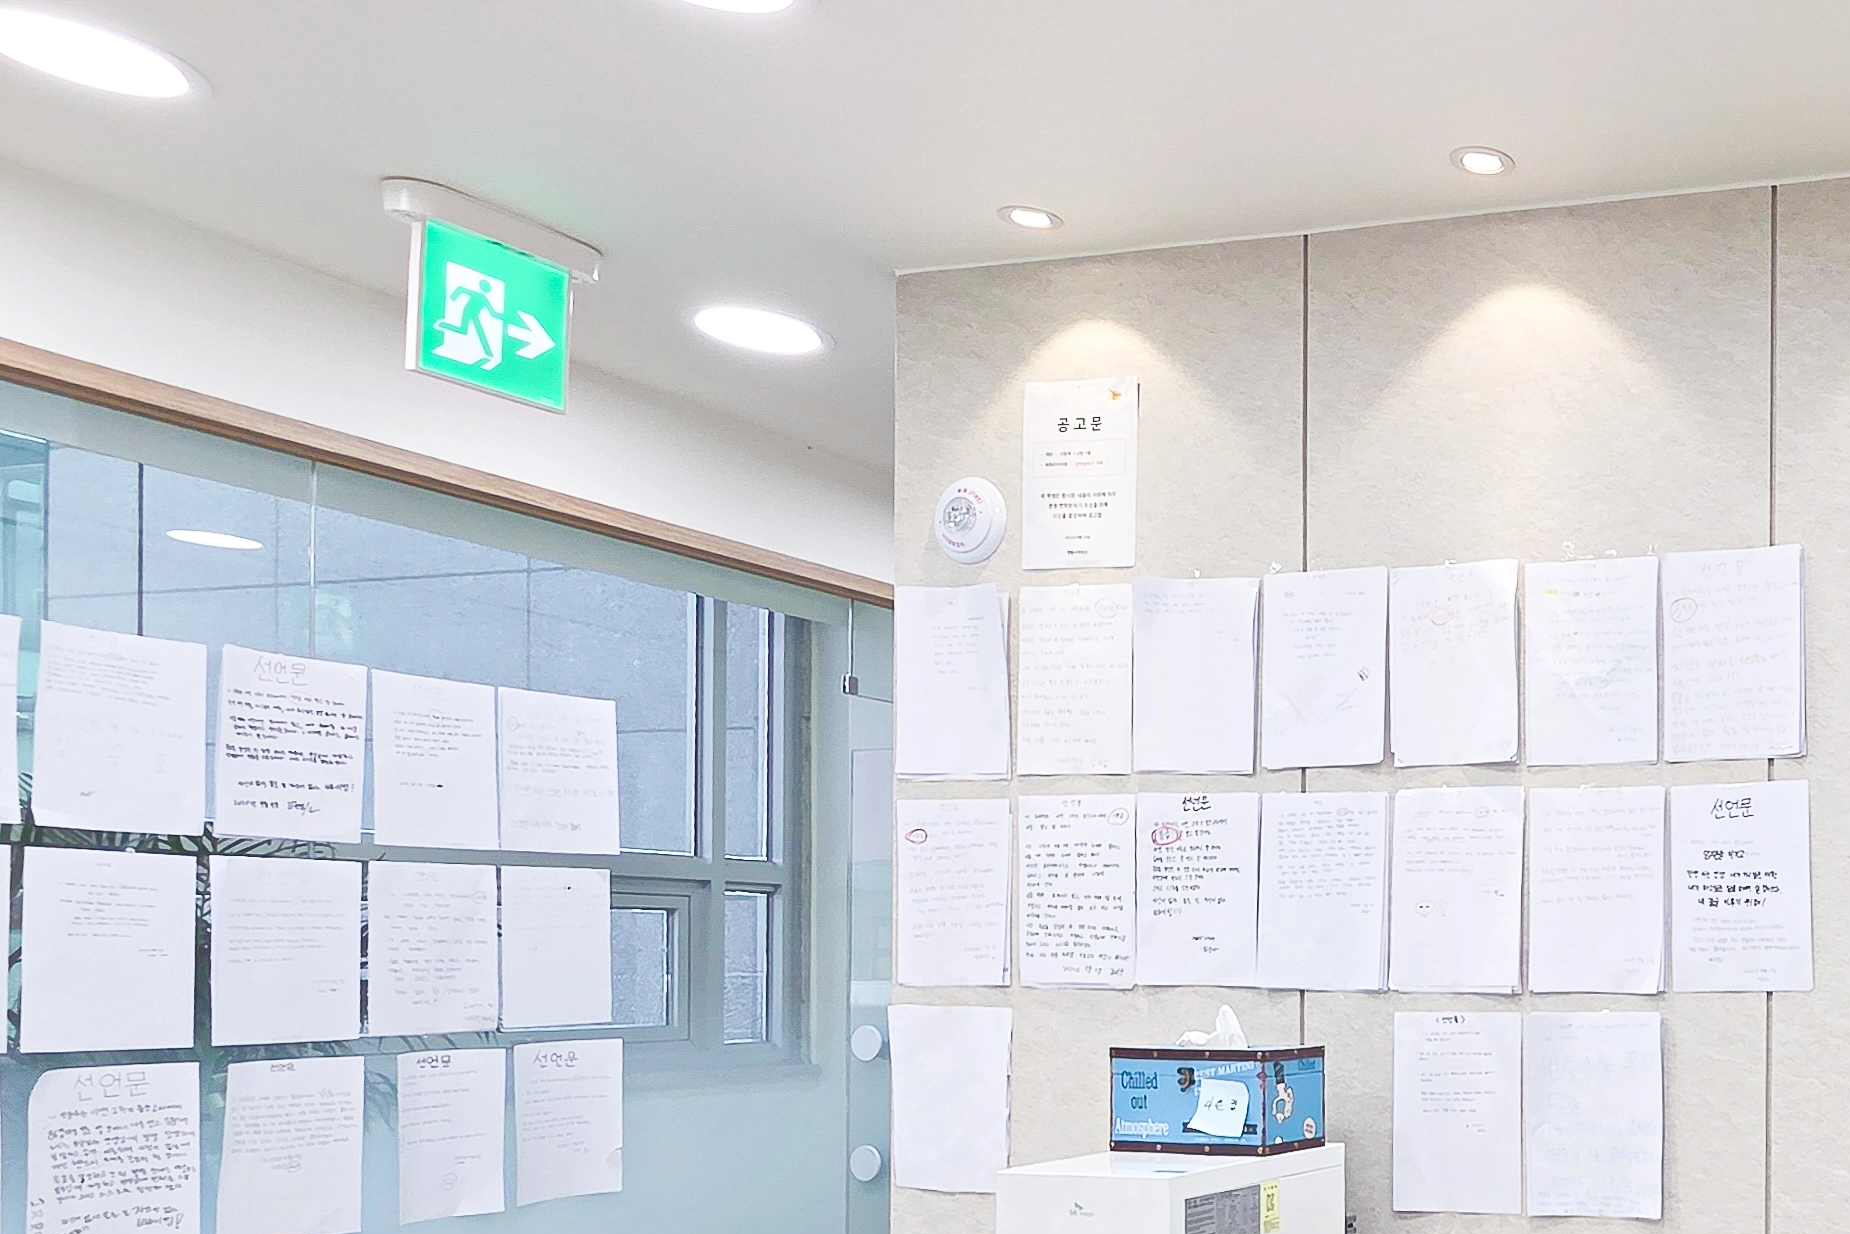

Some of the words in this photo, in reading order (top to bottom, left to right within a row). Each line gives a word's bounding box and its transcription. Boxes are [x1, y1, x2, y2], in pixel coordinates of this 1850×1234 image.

[1056, 416, 1104, 433] 공고문
[252, 655, 308, 686] 선언문
[1181, 794, 1212, 812] 선언문
[1710, 797, 1755, 820] 선언문
[416, 1054, 452, 1069] 선언문
[74, 1071, 150, 1102] 선언문
[1120, 1070, 1158, 1090] Chilled
[1130, 1094, 1148, 1110] out
[1114, 1116, 1170, 1139] Atmosphere
